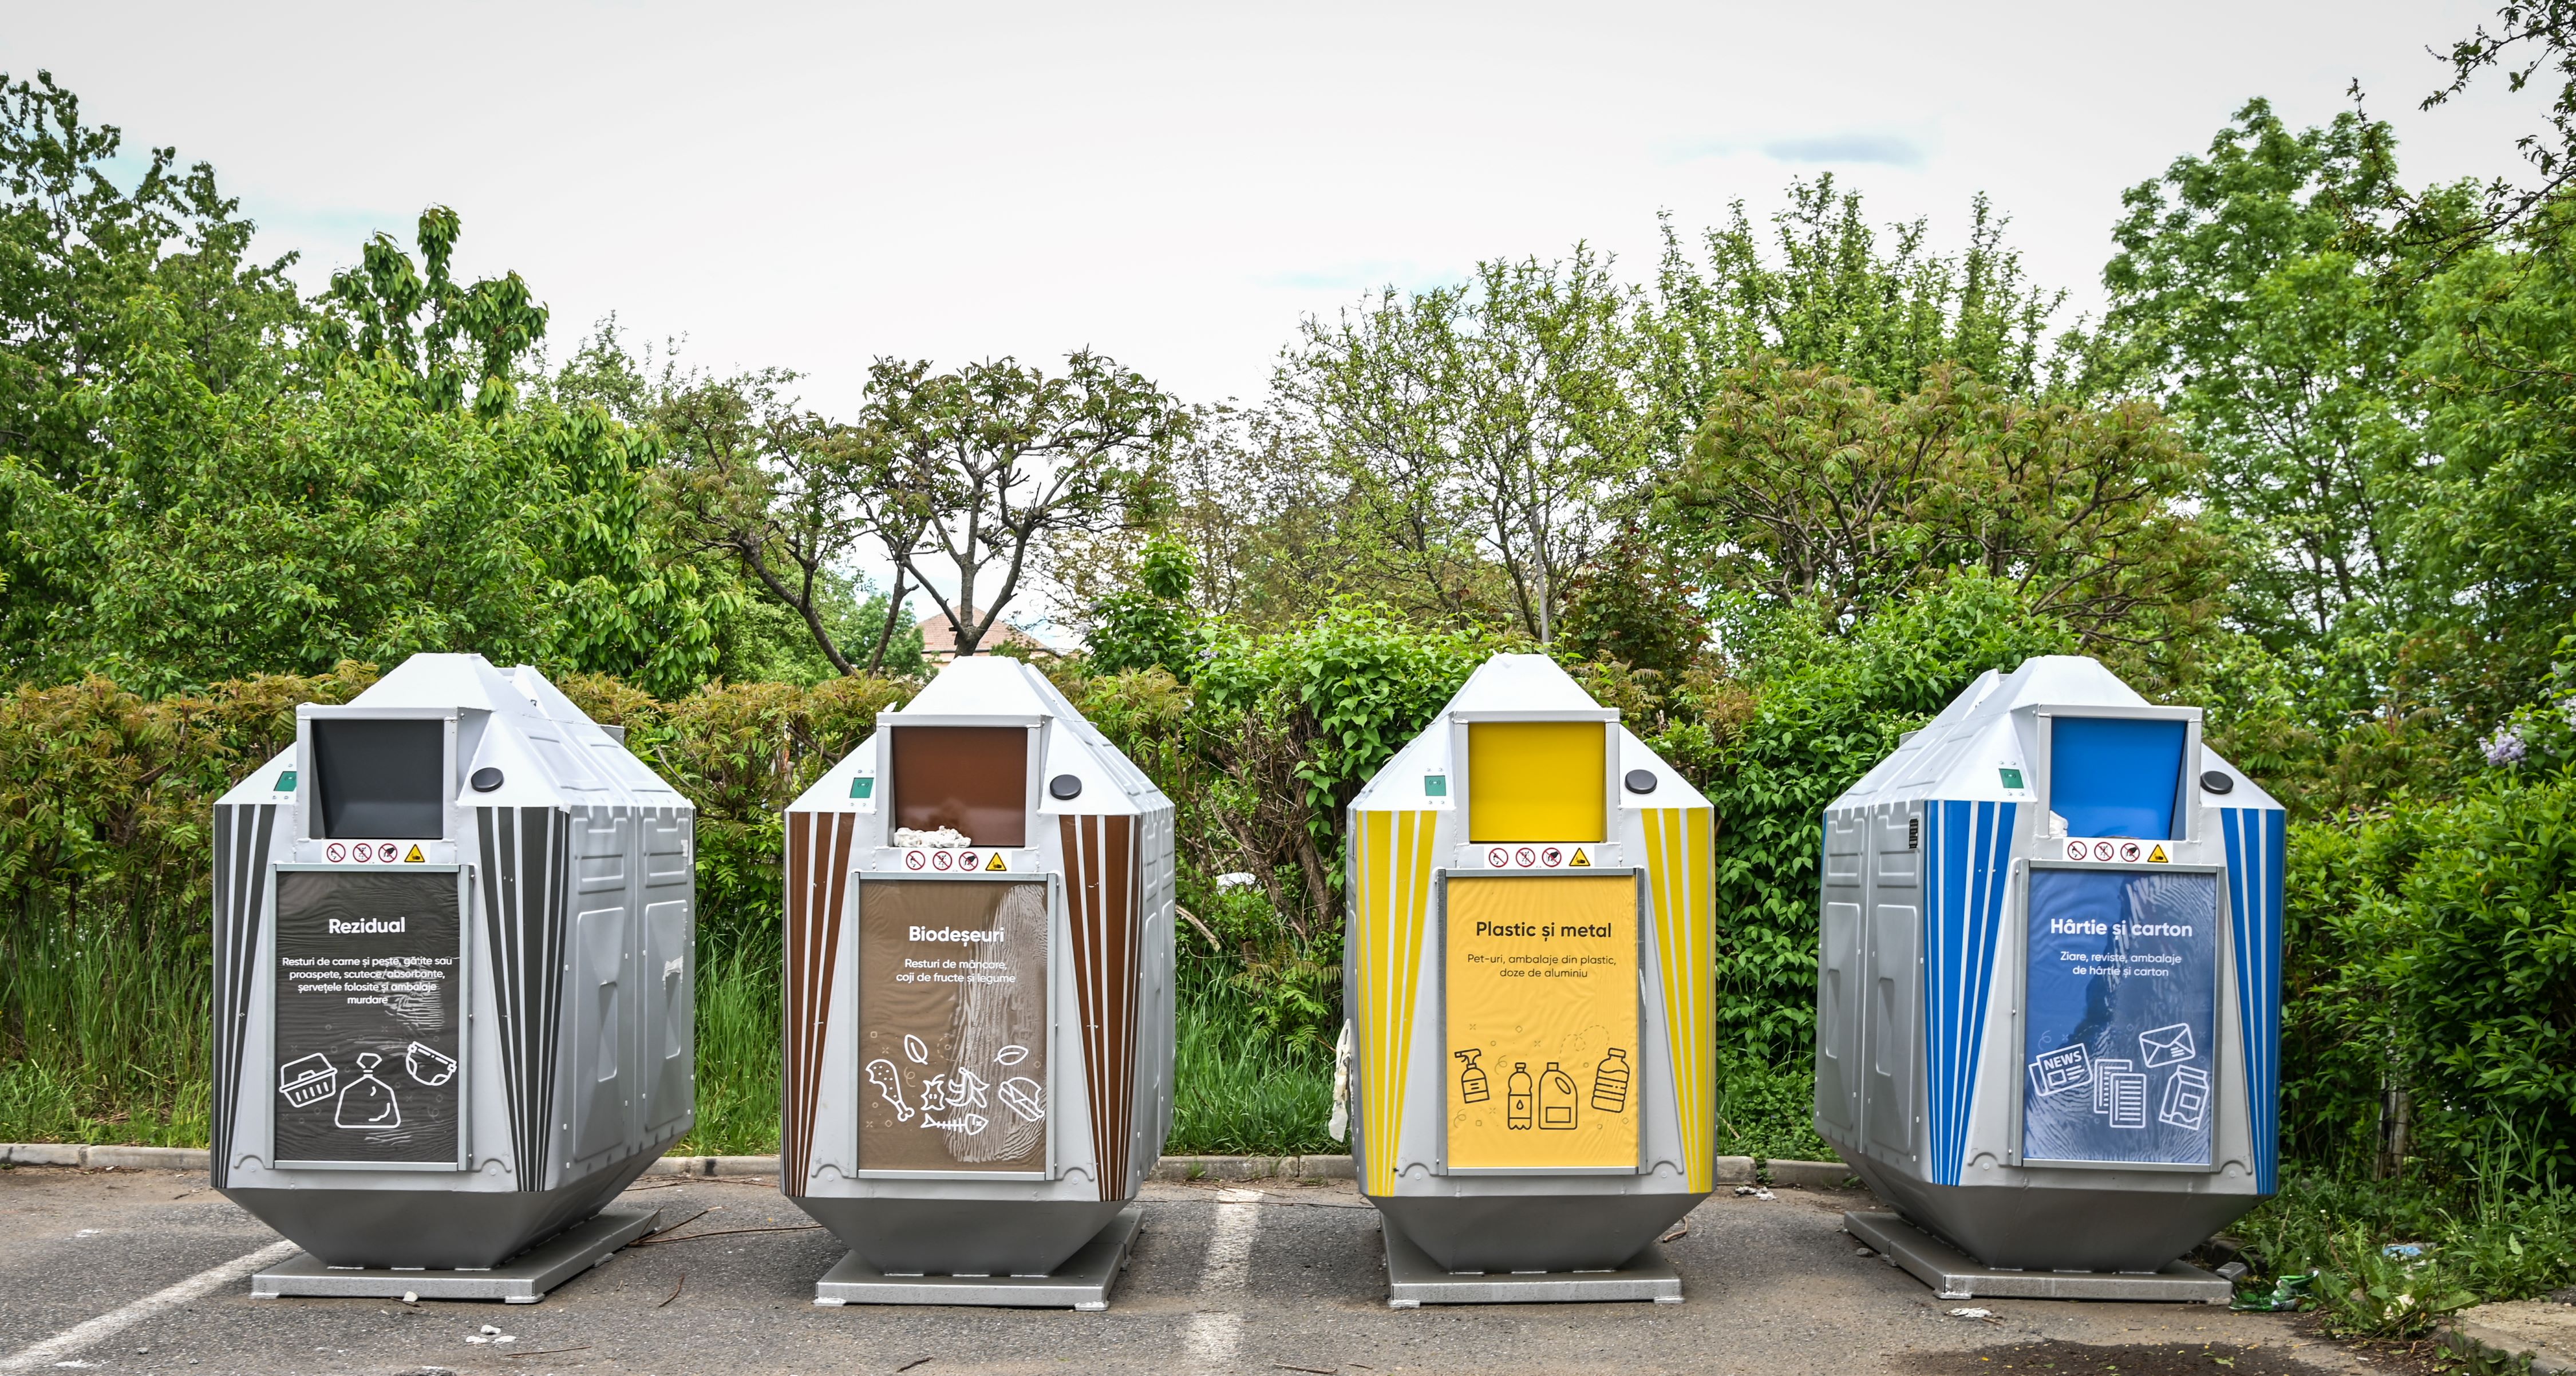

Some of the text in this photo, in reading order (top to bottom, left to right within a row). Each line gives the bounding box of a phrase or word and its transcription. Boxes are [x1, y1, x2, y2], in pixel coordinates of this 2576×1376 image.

[329, 917, 405, 934] Rezidual
[2050, 919, 2192, 940] Hârtie și carton
[909, 926, 1004, 947] Biodeșeuri
[1476, 922, 1611, 942] Plastic și metal
[282, 958, 315, 966] Resturi
[317, 958, 330, 966] de
[362, 957, 370, 967] și
[372, 958, 401, 967] pește,
[1468, 954, 1616, 966] Pet-uri, ambalaje din plastic,
[2060, 951, 2182, 965] Ziare, reviste, ambalaje
[905, 959, 1007, 970] Resturi de mâncare,
[290, 968, 445, 980] proaspete, scutece/absorbante,
[1500, 968, 1587, 978] doze de aluminiu
[2073, 965, 2168, 978] de hârtie și carton
[896, 972, 1016, 984] coji de fructe și legume
[298, 982, 437, 994] șervețele folosite și ambalaje
[347, 996, 388, 1004] murdare
[2043, 1051, 2082, 1070] NEWS
